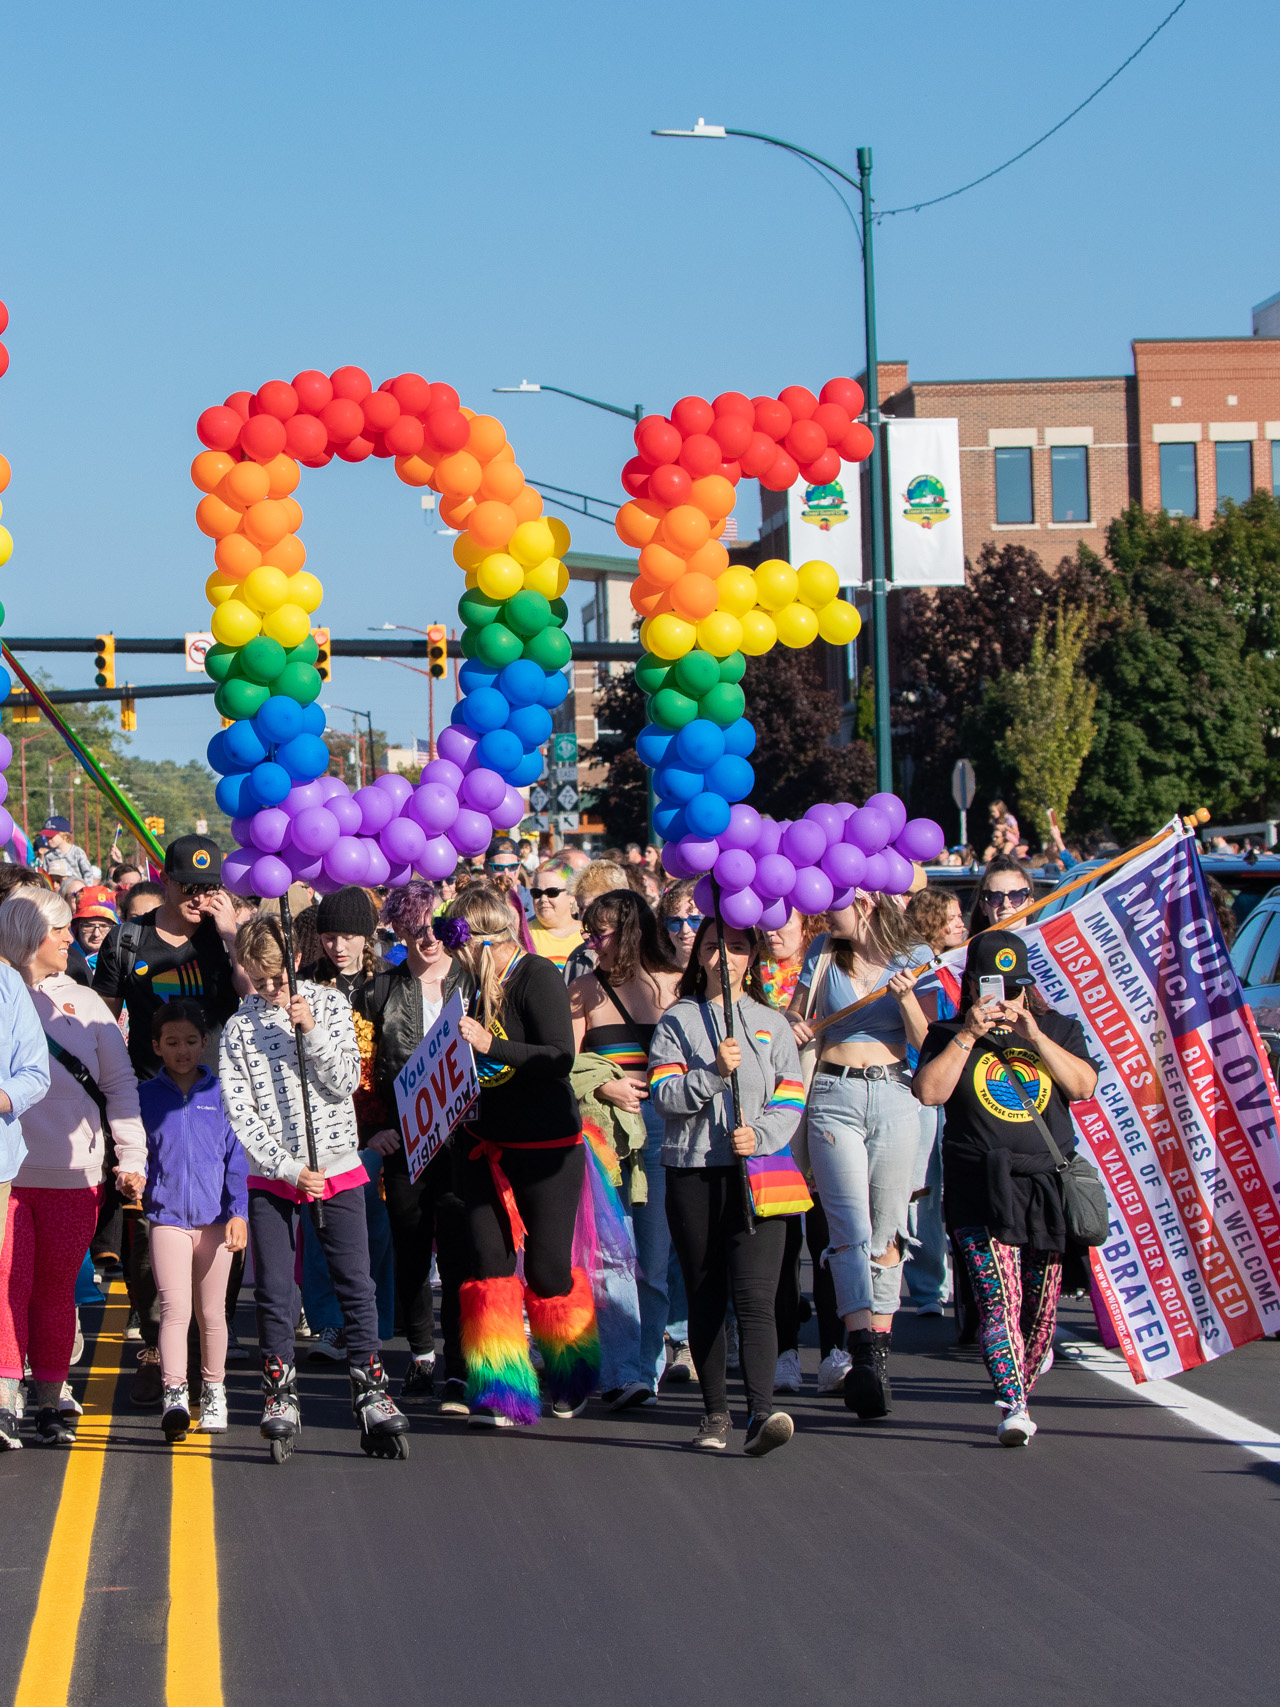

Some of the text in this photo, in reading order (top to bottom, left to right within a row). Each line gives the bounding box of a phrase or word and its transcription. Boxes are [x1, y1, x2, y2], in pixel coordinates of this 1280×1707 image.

[562, 794, 575, 805] 72
[1117, 882, 1196, 1020] AMERICA
[1151, 850, 1238, 1005] IN OUR
[399, 1055, 426, 1098] You
[428, 1019, 451, 1060] are
[401, 1038, 465, 1158] LOVE
[410, 1121, 441, 1175] right
[445, 1066, 478, 1128] now!
[980, 1088, 1007, 1116] TRAVERSE
[1017, 1050, 1040, 1064] PRIDE
[1084, 911, 1280, 1316] IMMIGRANTS & REFUGEES ARE WELCOME
[1181, 1045, 1228, 1119] BLACK
[1218, 1125, 1261, 1193] LIVES
[1208, 1026, 1277, 1148] LOVE
[1027, 942, 1070, 1004] WOMEN
[1100, 1082, 1147, 1157] CHARGE
[1140, 1163, 1162, 1189] OF
[1155, 1197, 1189, 1260] THEIR
[1181, 1268, 1220, 1341] BODIES
[1054, 936, 1249, 1319] DISABILITIES ARE RESPECTED
[1081, 1112, 1111, 1144] ARE
[1102, 1149, 1142, 1216] VALUED
[1135, 1222, 1164, 1271] OVER
[1156, 1276, 1194, 1339] PROFIT
